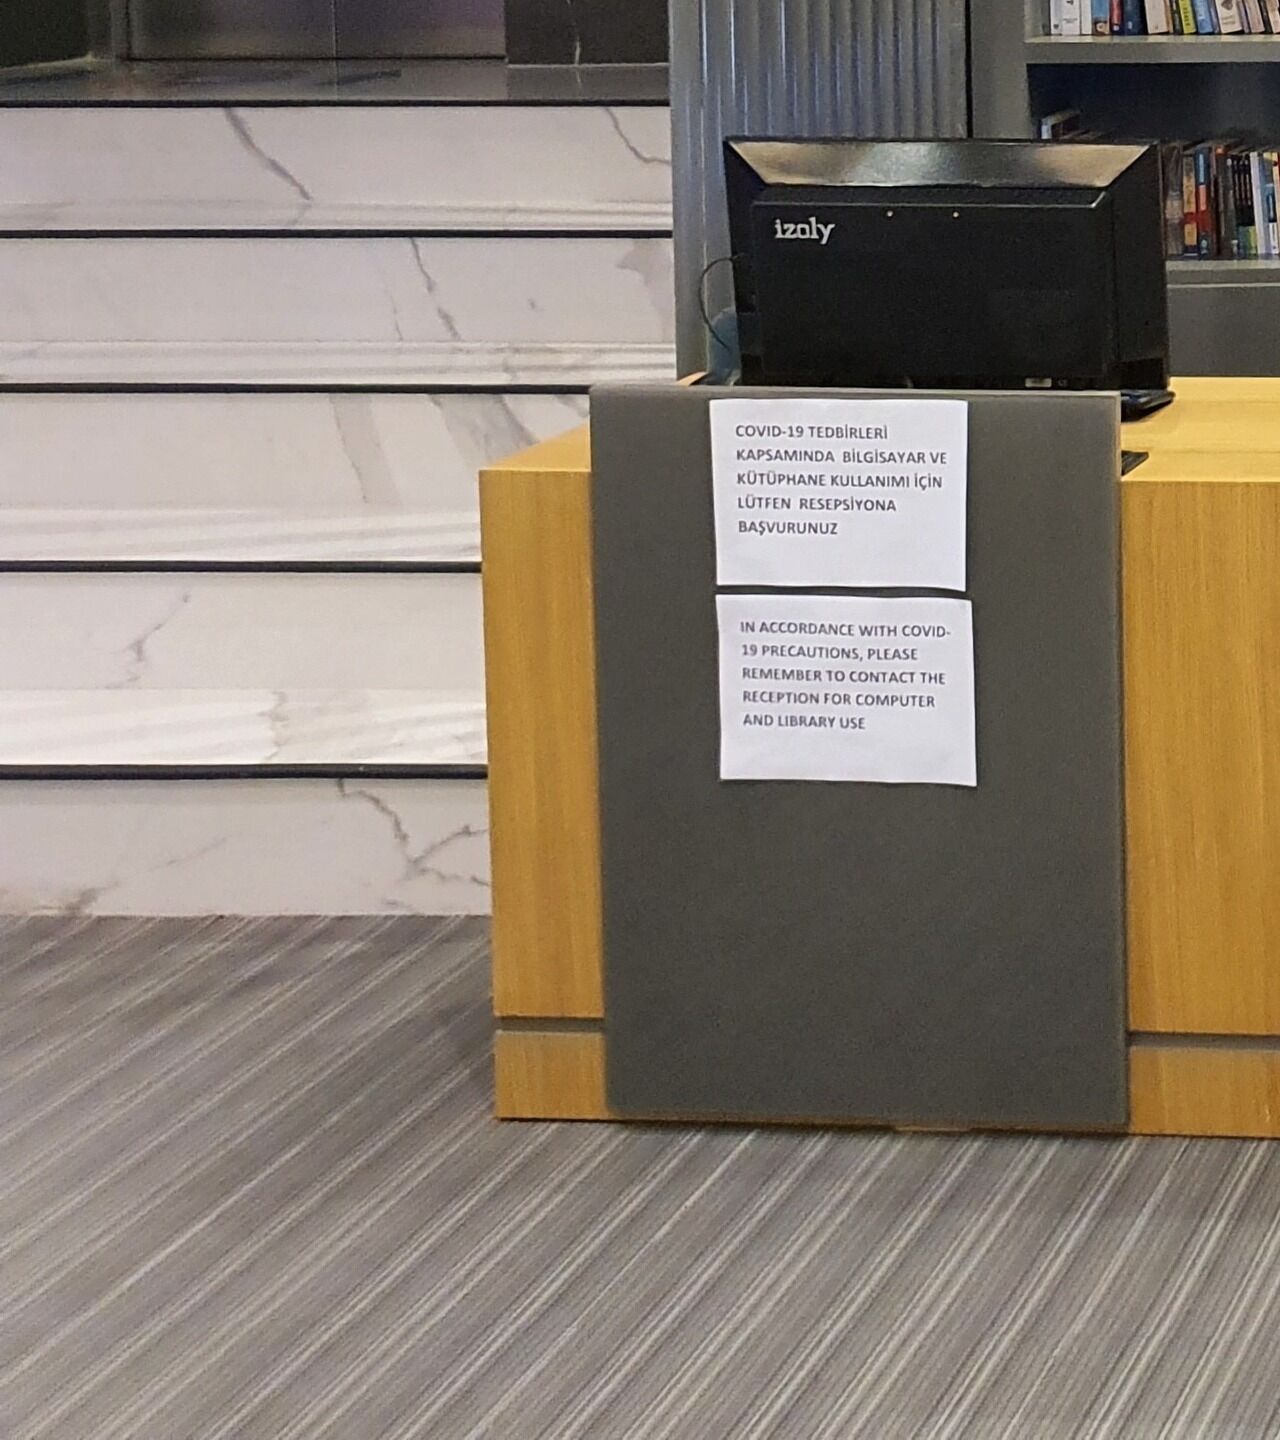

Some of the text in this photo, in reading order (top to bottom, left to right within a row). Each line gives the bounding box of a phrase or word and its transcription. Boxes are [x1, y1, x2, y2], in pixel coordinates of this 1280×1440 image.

[774, 216, 836, 245] izoly
[735, 423, 888, 440] COVID-19 TEDBİRLERİ
[736, 447, 947, 465] KAPSAMINDA BİLGİSAYAR VE
[736, 469, 943, 492] KÜTÜPHANE KULLANIMI İÇİN
[737, 493, 897, 512] LÜTFEN RESEPSİYONA
[738, 520, 839, 537] BAŞVURUNUZ
[739, 620, 952, 638] IN ACCORDANCE WITH COVID-
[741, 643, 918, 663] 19 PRECAUTIONS, PLEASE
[741, 666, 946, 686] REMEMBER TO CONTACT THE
[742, 690, 936, 708] RECEPTION FOR COMPUTER
[742, 713, 866, 730] AND LIBRARY USE
